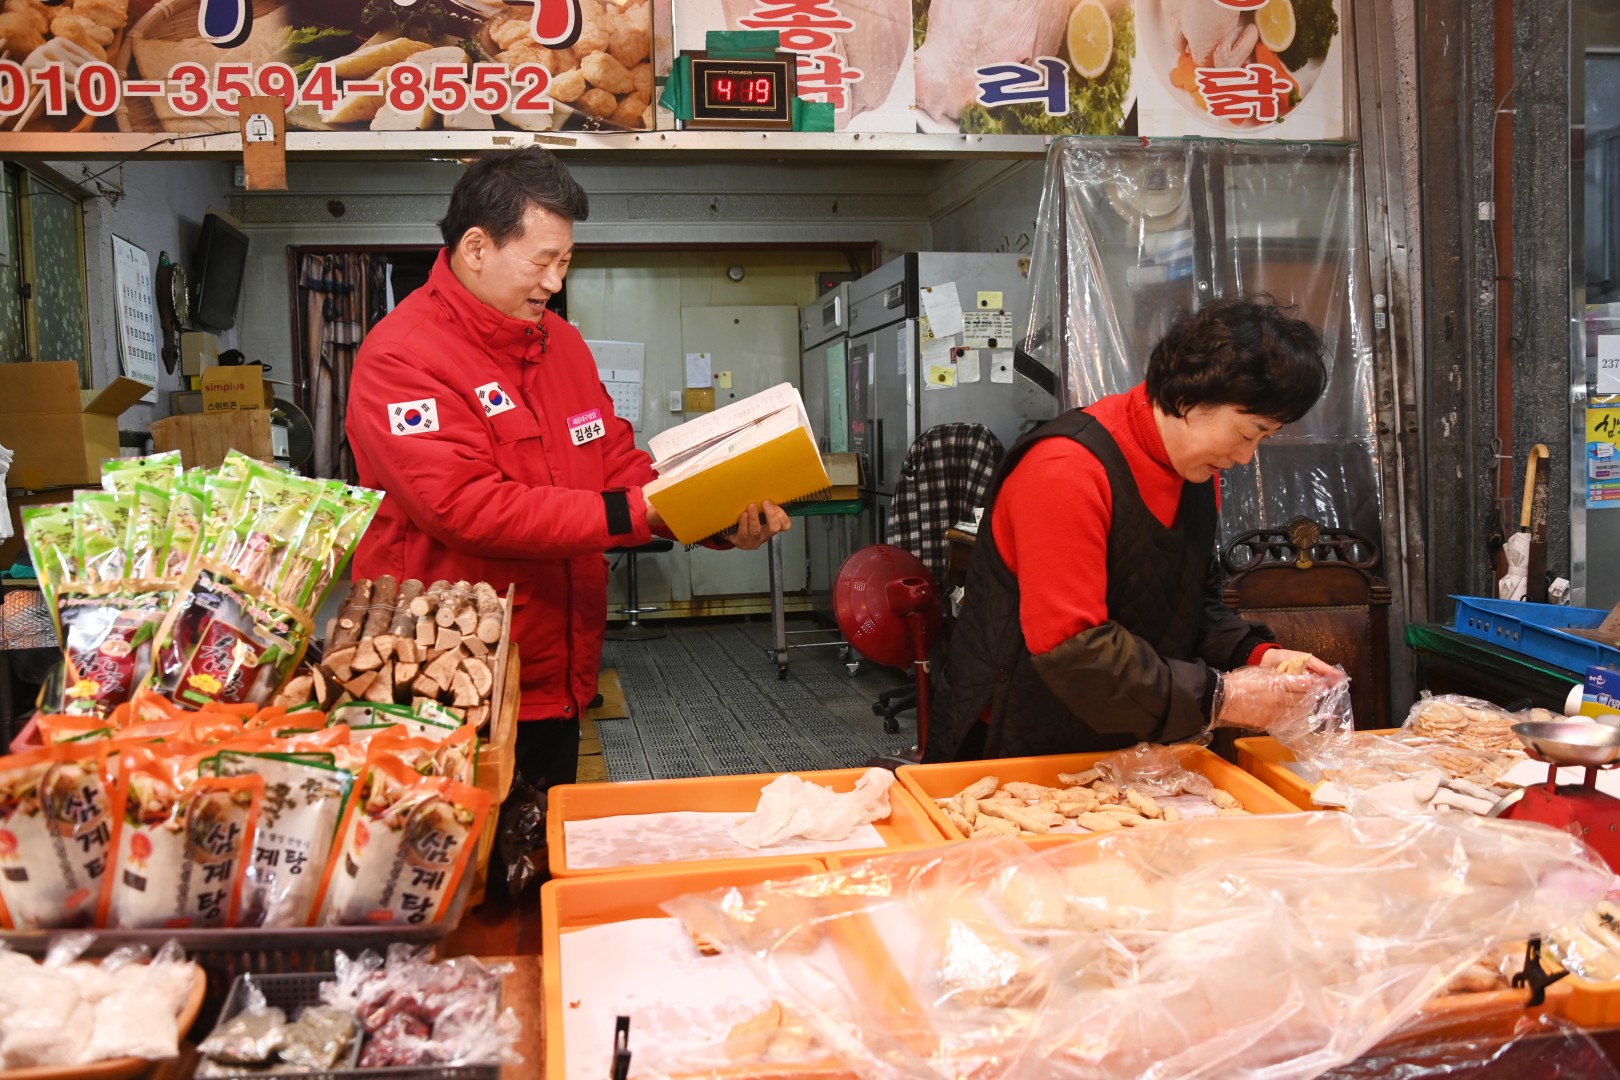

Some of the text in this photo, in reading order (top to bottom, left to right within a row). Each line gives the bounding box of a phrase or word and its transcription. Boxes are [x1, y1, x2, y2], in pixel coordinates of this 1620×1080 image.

[976, 57, 1069, 116] 리
[205, 382, 245, 393] simplus
[207, 401, 237, 411] 스위트콘
[574, 423, 602, 442] 김성수
[196, 821, 240, 920] 삼계탕
[256, 847, 309, 875] 계탕
[401, 831, 458, 924] 삼계탕
